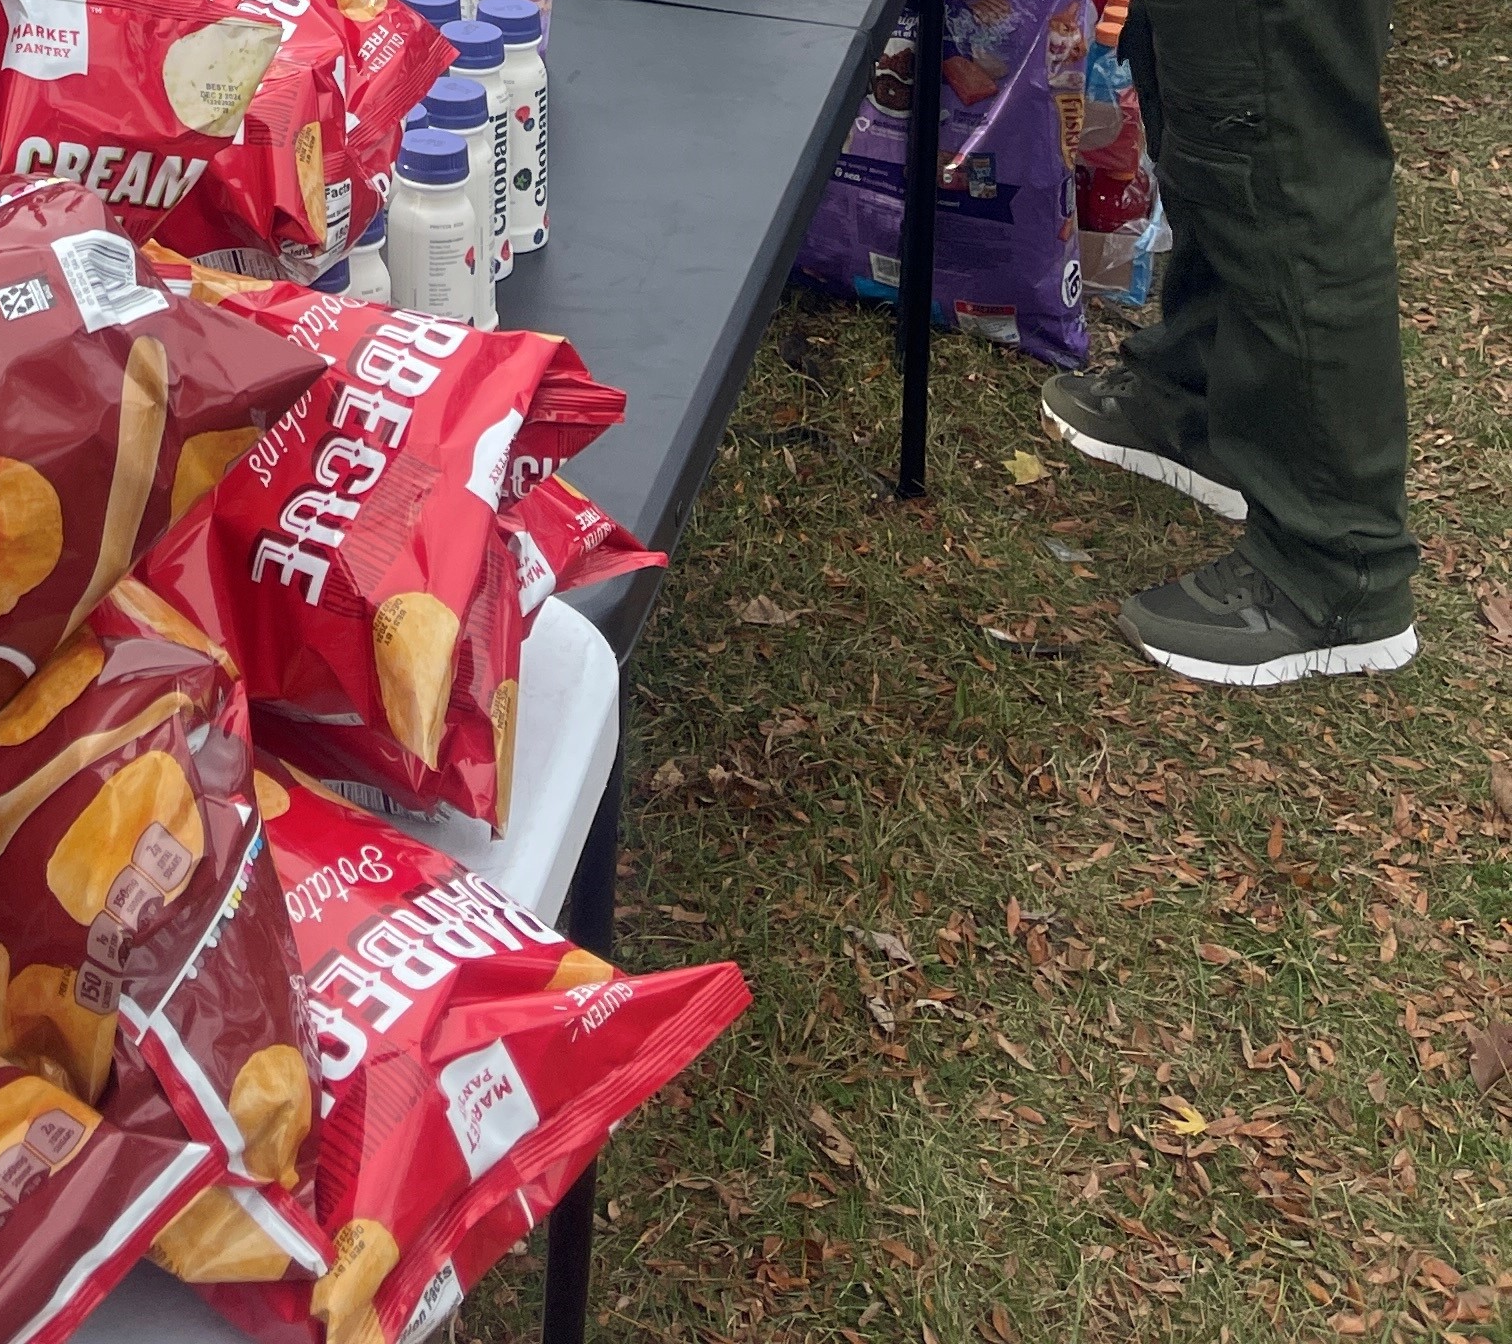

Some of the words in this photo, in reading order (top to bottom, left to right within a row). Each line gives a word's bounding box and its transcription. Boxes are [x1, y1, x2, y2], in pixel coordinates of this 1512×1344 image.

[12, 23, 82, 46] MARKET
[15, 43, 73, 60] PANTRY
[357, 24, 390, 62] FREE
[368, 32, 405, 73] GLUTEN
[200, 91, 217, 100] DEC
[206, 83, 227, 92] BEST
[535, 86, 548, 208] Chobani
[13, 136, 209, 211] CREAM
[325, 183, 351, 200] Facts
[285, 843, 396, 927] Potato
[80, 971, 103, 1003] 150
[580, 980, 636, 1036] GLUTEN
[423, 1263, 454, 1312] Facts
